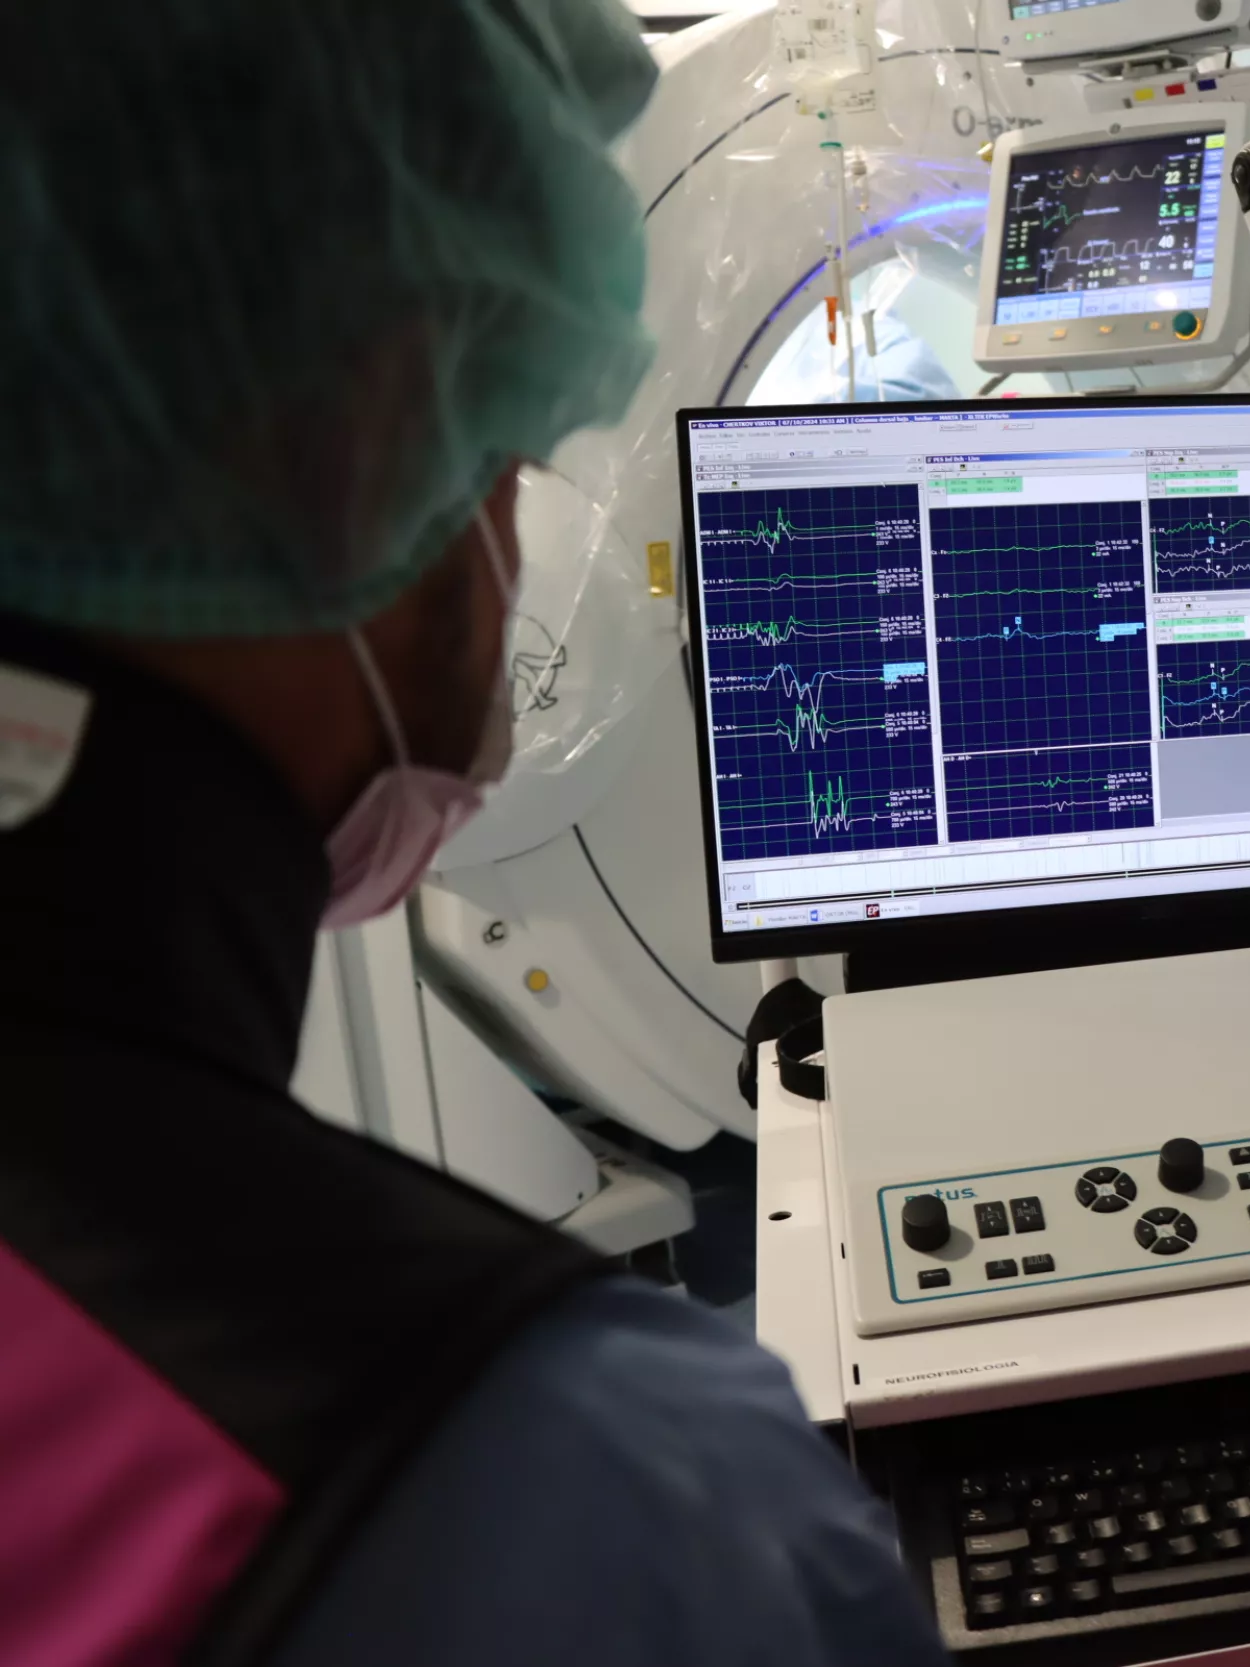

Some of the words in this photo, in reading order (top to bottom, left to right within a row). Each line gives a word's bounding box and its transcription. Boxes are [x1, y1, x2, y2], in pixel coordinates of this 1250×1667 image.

[1164, 170, 1180, 185] 22
[1159, 203, 1180, 217] 5.5
[1158, 234, 1175, 249] 40
[904, 1187, 977, 1201] tus
[885, 1361, 1020, 1385] NEUROFISIOLOGIA
